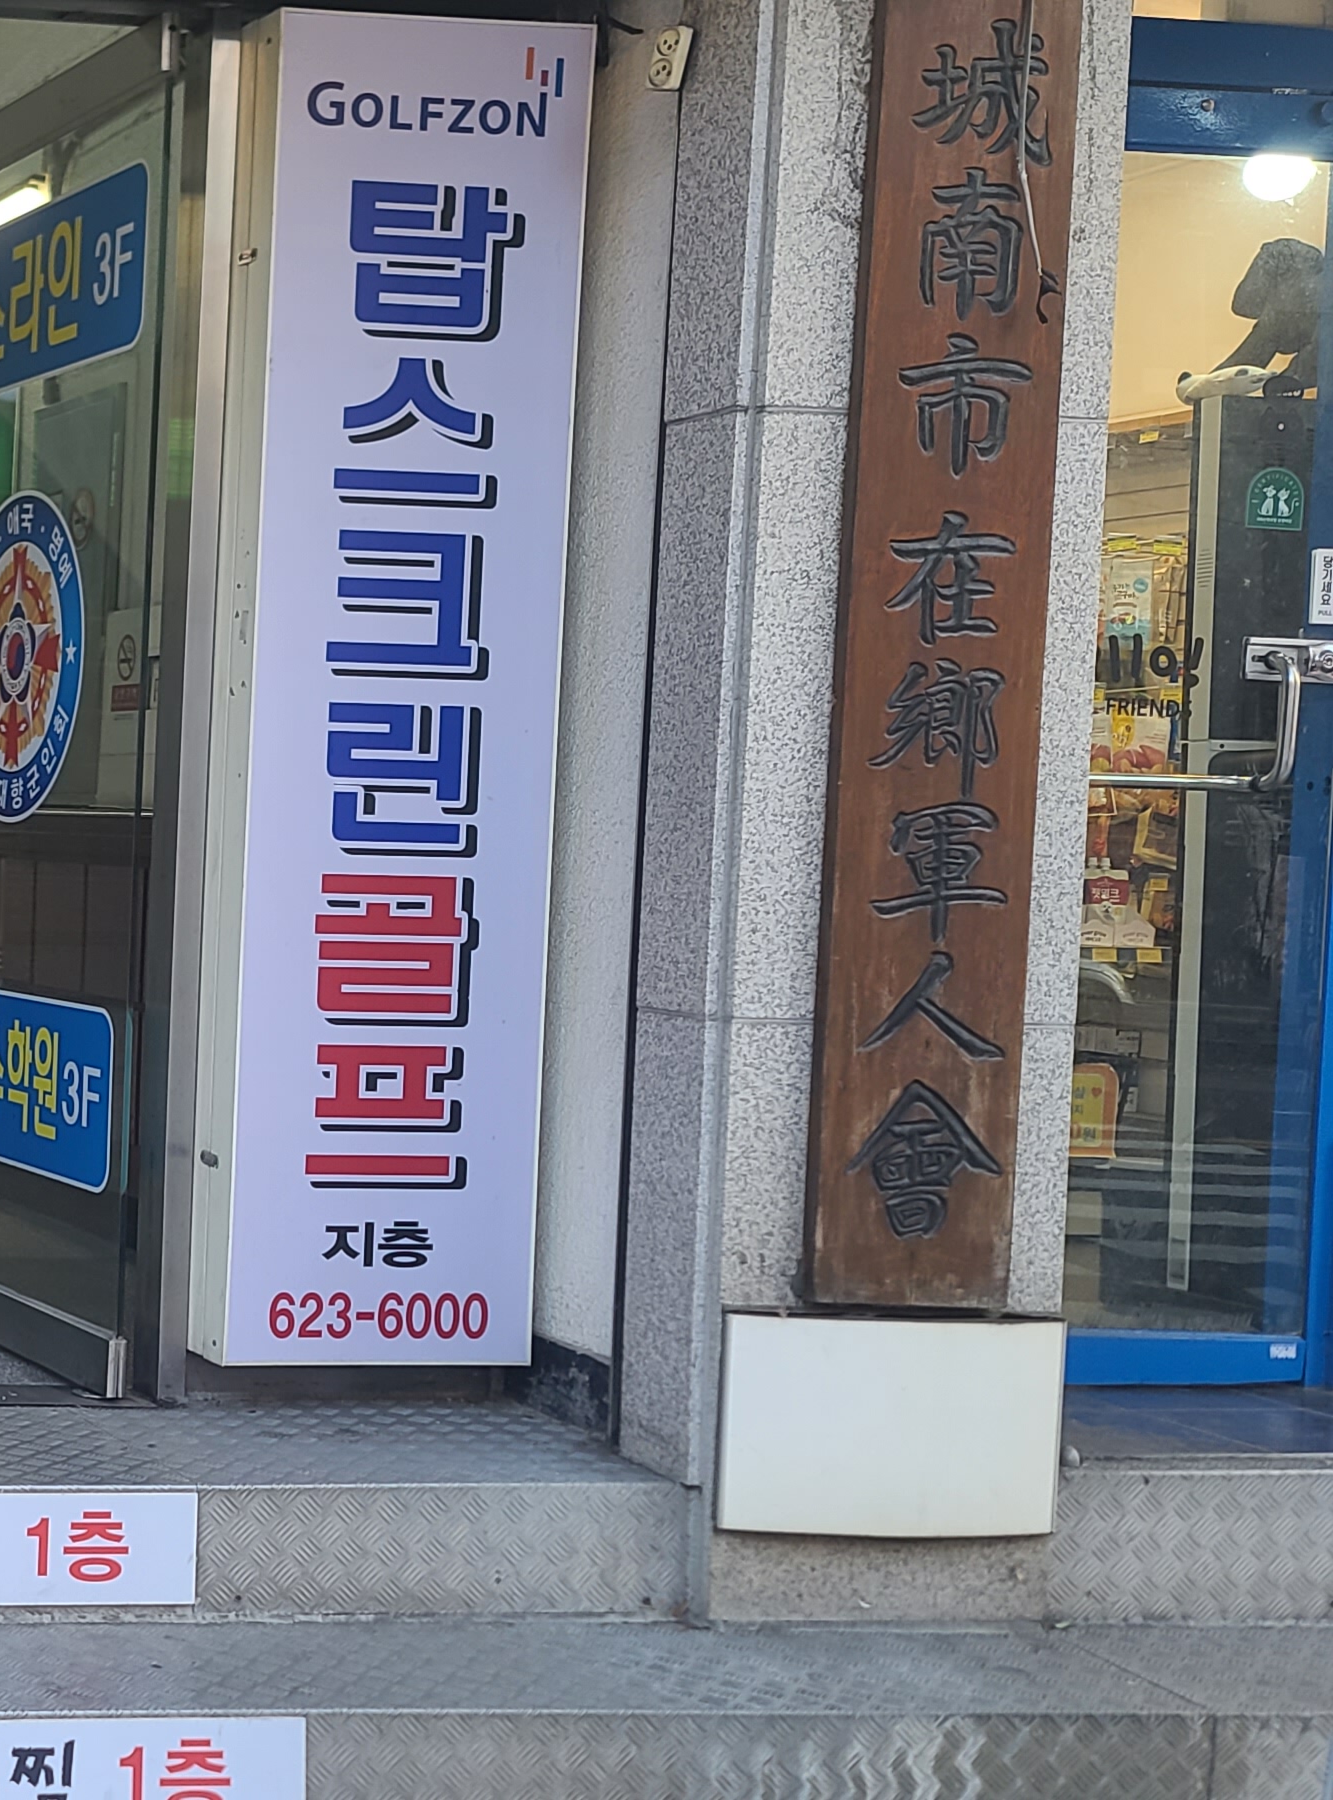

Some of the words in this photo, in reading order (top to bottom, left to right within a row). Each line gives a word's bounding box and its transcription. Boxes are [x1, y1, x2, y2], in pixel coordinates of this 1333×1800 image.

[307, 81, 548, 138] GOLFZON
[93, 222, 135, 307] 3F
[1320, 556, 1333, 605] 당기세요
[61, 1060, 102, 1128] 3F
[322, 1220, 433, 1269] 지층
[268, 1291, 488, 1340] 623-6000
[24, 1510, 131, 1584] 1층
[119, 1737, 234, 1800] 1층
